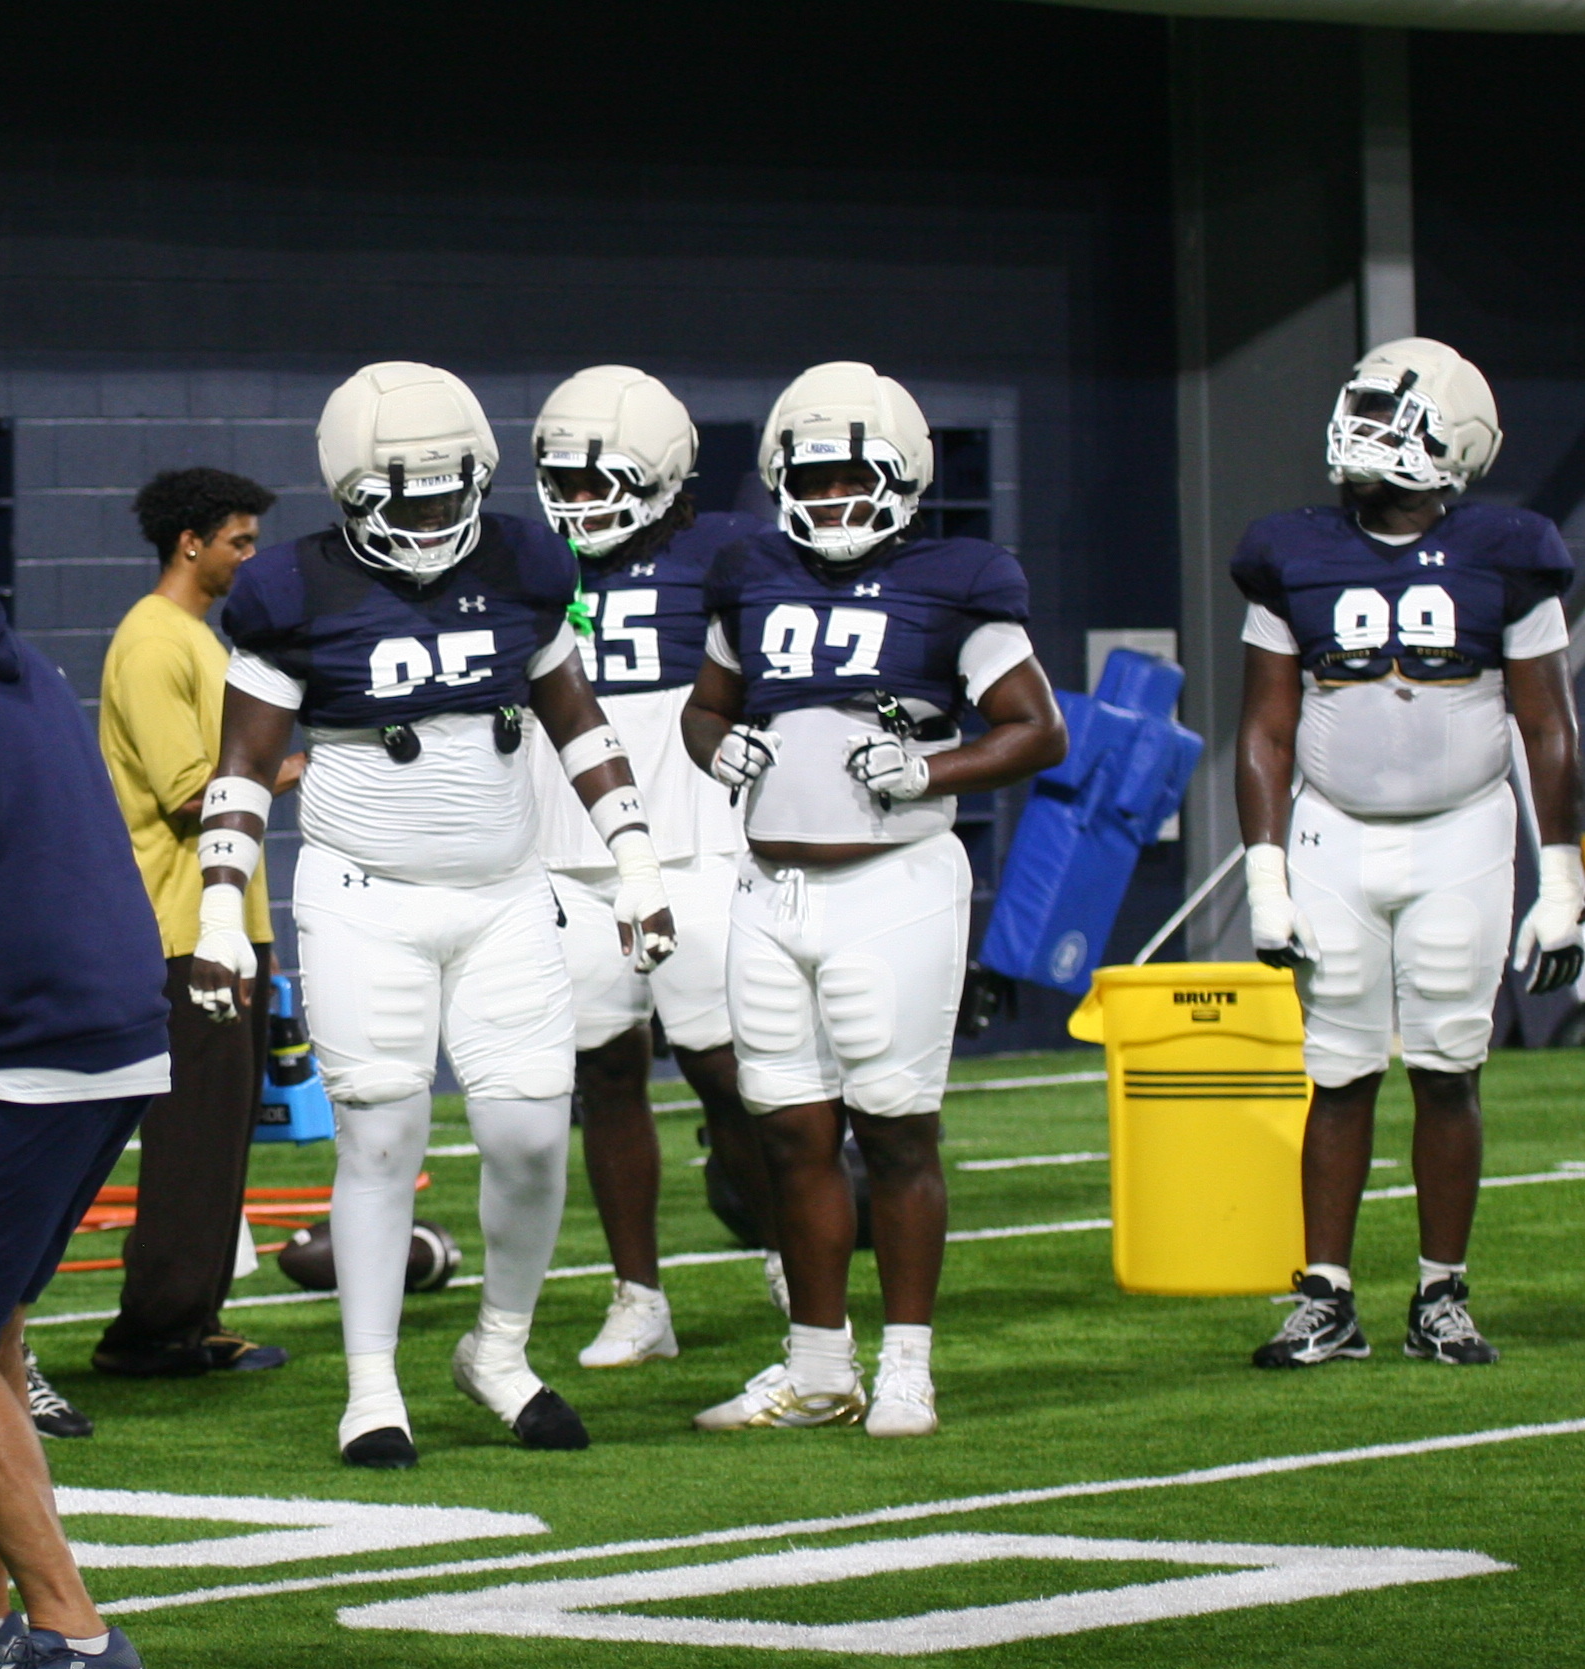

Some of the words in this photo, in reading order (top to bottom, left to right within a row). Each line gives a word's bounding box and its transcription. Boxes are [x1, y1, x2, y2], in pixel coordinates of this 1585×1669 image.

[760, 603, 888, 679] 97
[1334, 584, 1456, 650] 99
[1173, 991, 1238, 1005] BRUTE
